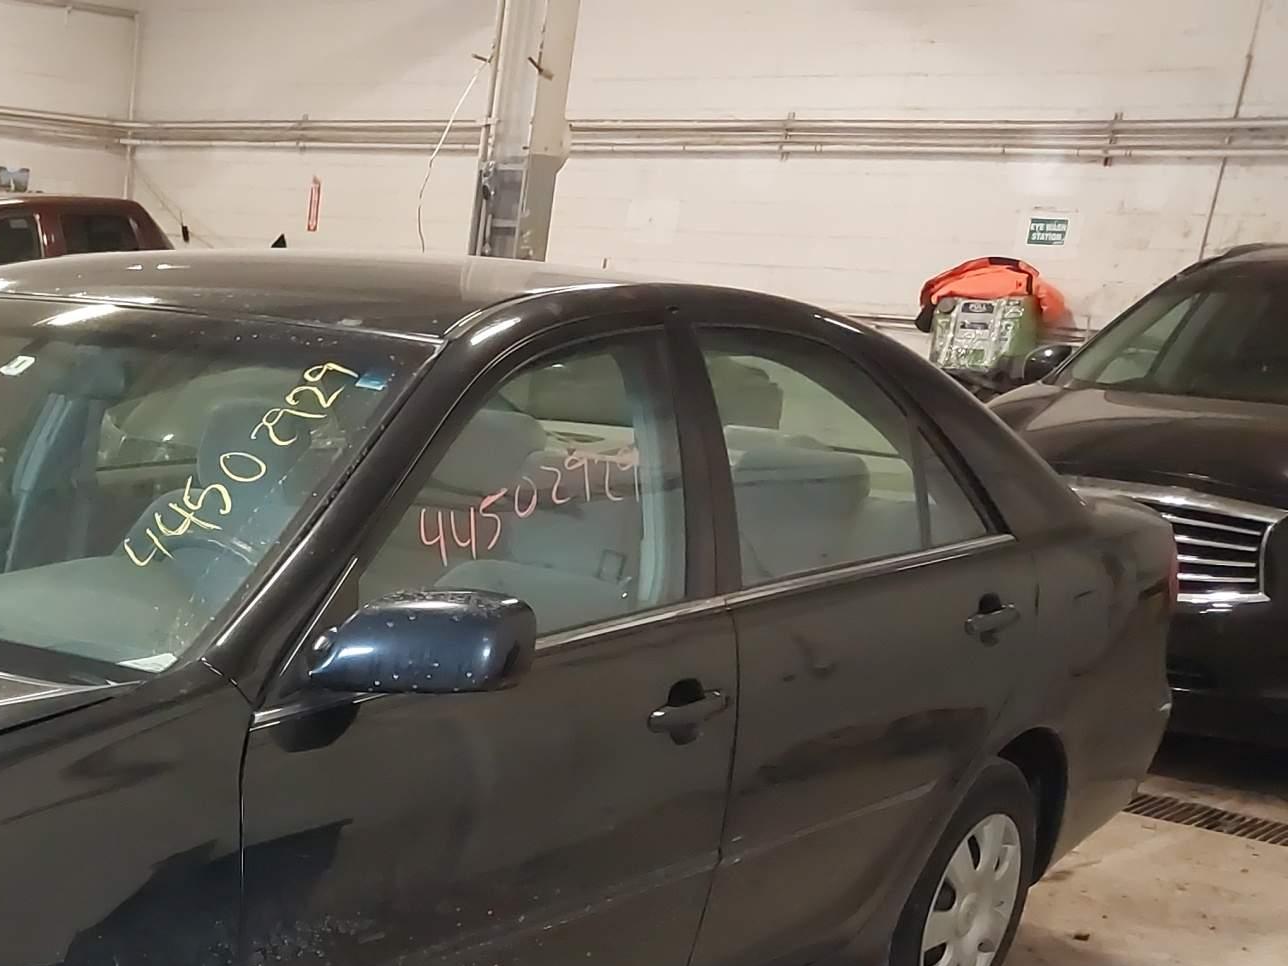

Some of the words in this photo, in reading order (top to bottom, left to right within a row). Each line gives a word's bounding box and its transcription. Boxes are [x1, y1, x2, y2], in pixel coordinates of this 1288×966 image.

[1031, 232, 1062, 241] STATION
[123, 362, 360, 567] 44502929
[419, 445, 640, 567] 44502929
